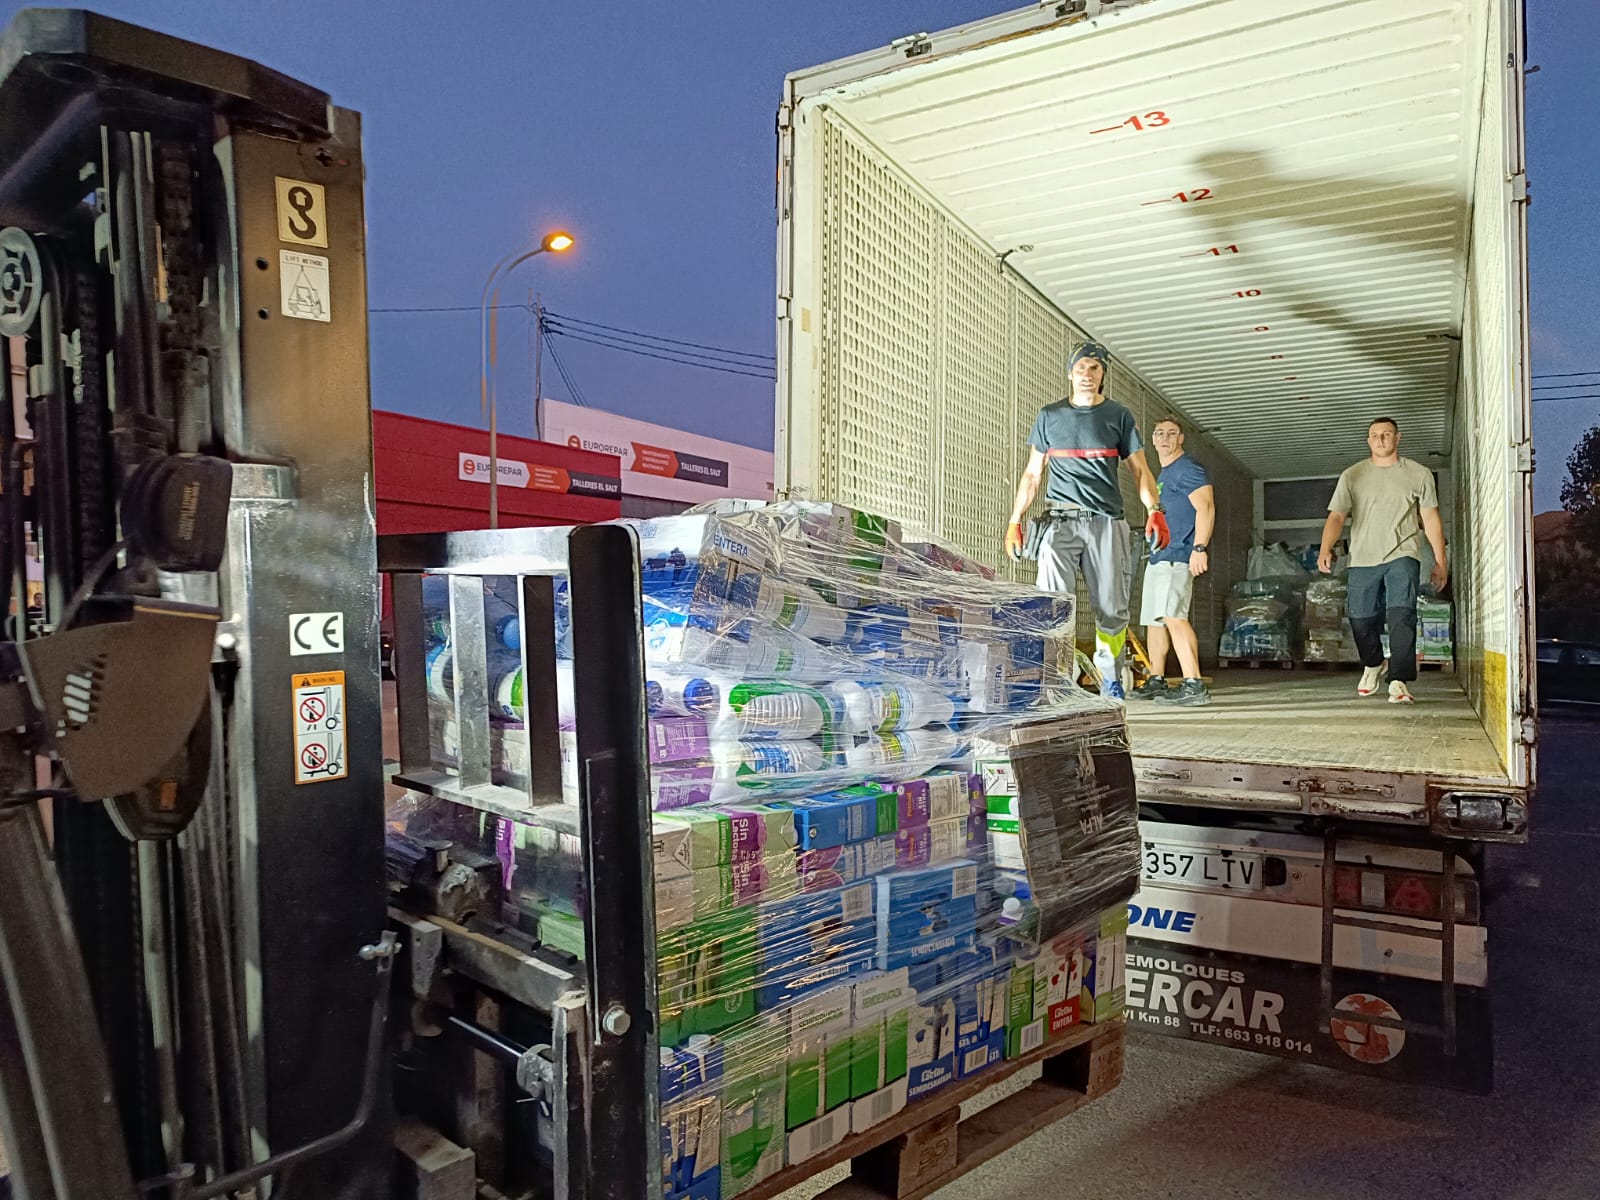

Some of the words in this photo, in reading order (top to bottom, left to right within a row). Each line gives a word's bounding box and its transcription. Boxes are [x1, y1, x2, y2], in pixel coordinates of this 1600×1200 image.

[1123, 111, 1170, 131] 13
[1172, 188, 1214, 203] 12
[1206, 244, 1239, 256] 11
[1232, 288, 1262, 298] 10
[583, 440, 628, 457] EUROREPAR
[476, 463, 522, 477] EURREPAR
[681, 462, 704, 474] TALLERES
[704, 467, 710, 475] EL
[710, 468, 722, 477] SALT
[572, 478, 598, 489] TALLERES
[598, 483, 604, 491] EL
[605, 484, 618, 492] SALT
[713, 534, 748, 557] ENTERA
[294, 615, 340, 650] CE
[739, 818, 749, 841] Sin
[1079, 815, 1103, 835] ALFA
[732, 819, 740, 861] Lactosa
[740, 863, 750, 887] Sin
[1146, 852, 1193, 877] 357
[1204, 857, 1254, 884] LTV
[1125, 953, 1245, 984] EMOLQUES
[1124, 968, 1285, 1034] ERCAR
[1053, 1014, 1073, 1031] ENTERA
[1138, 1011, 1160, 1024] Km
[1164, 1016, 1180, 1028] 88
[1190, 1021, 1221, 1037] TLF:
[1224, 1028, 1250, 1042] 663
[1254, 1034, 1281, 1048] 918
[1285, 1039, 1313, 1054] 014
